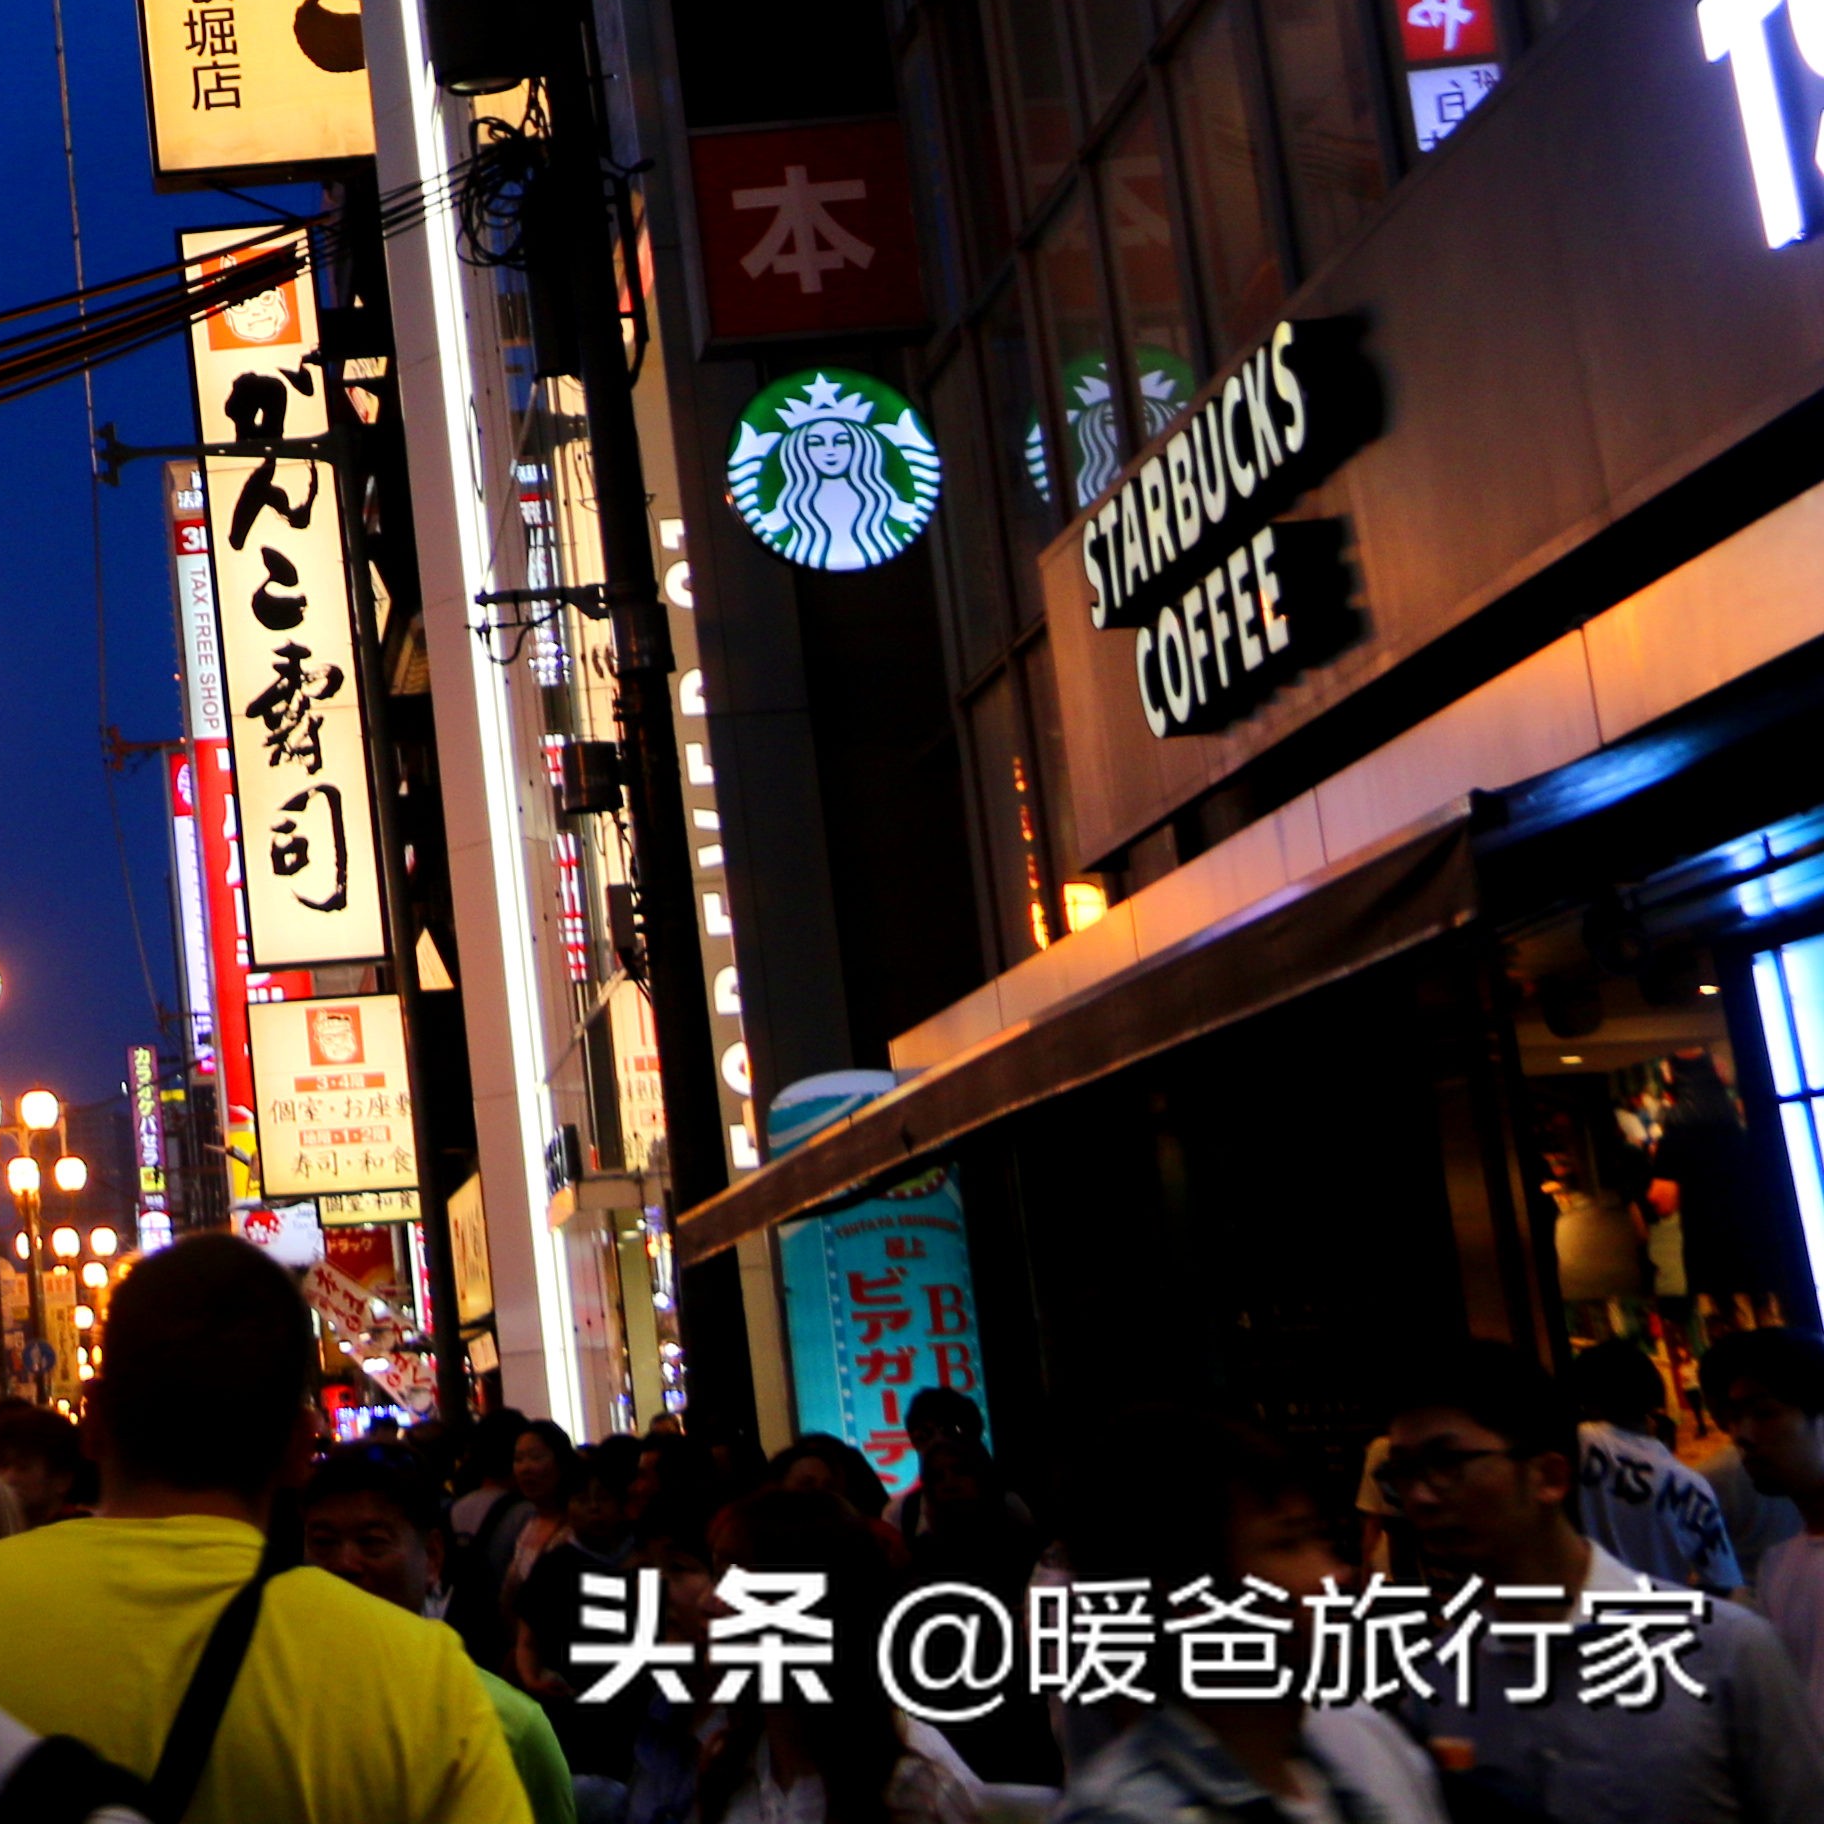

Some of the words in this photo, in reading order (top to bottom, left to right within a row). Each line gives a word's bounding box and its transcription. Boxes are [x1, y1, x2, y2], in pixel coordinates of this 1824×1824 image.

[731, 164, 878, 295] 本
[1082, 320, 1306, 630] STARBUCKS
[189, 566, 207, 607] TAX
[1136, 525, 1290, 740] COFFEE
[194, 611, 215, 666] FREE
[200, 672, 221, 731] SHOP
